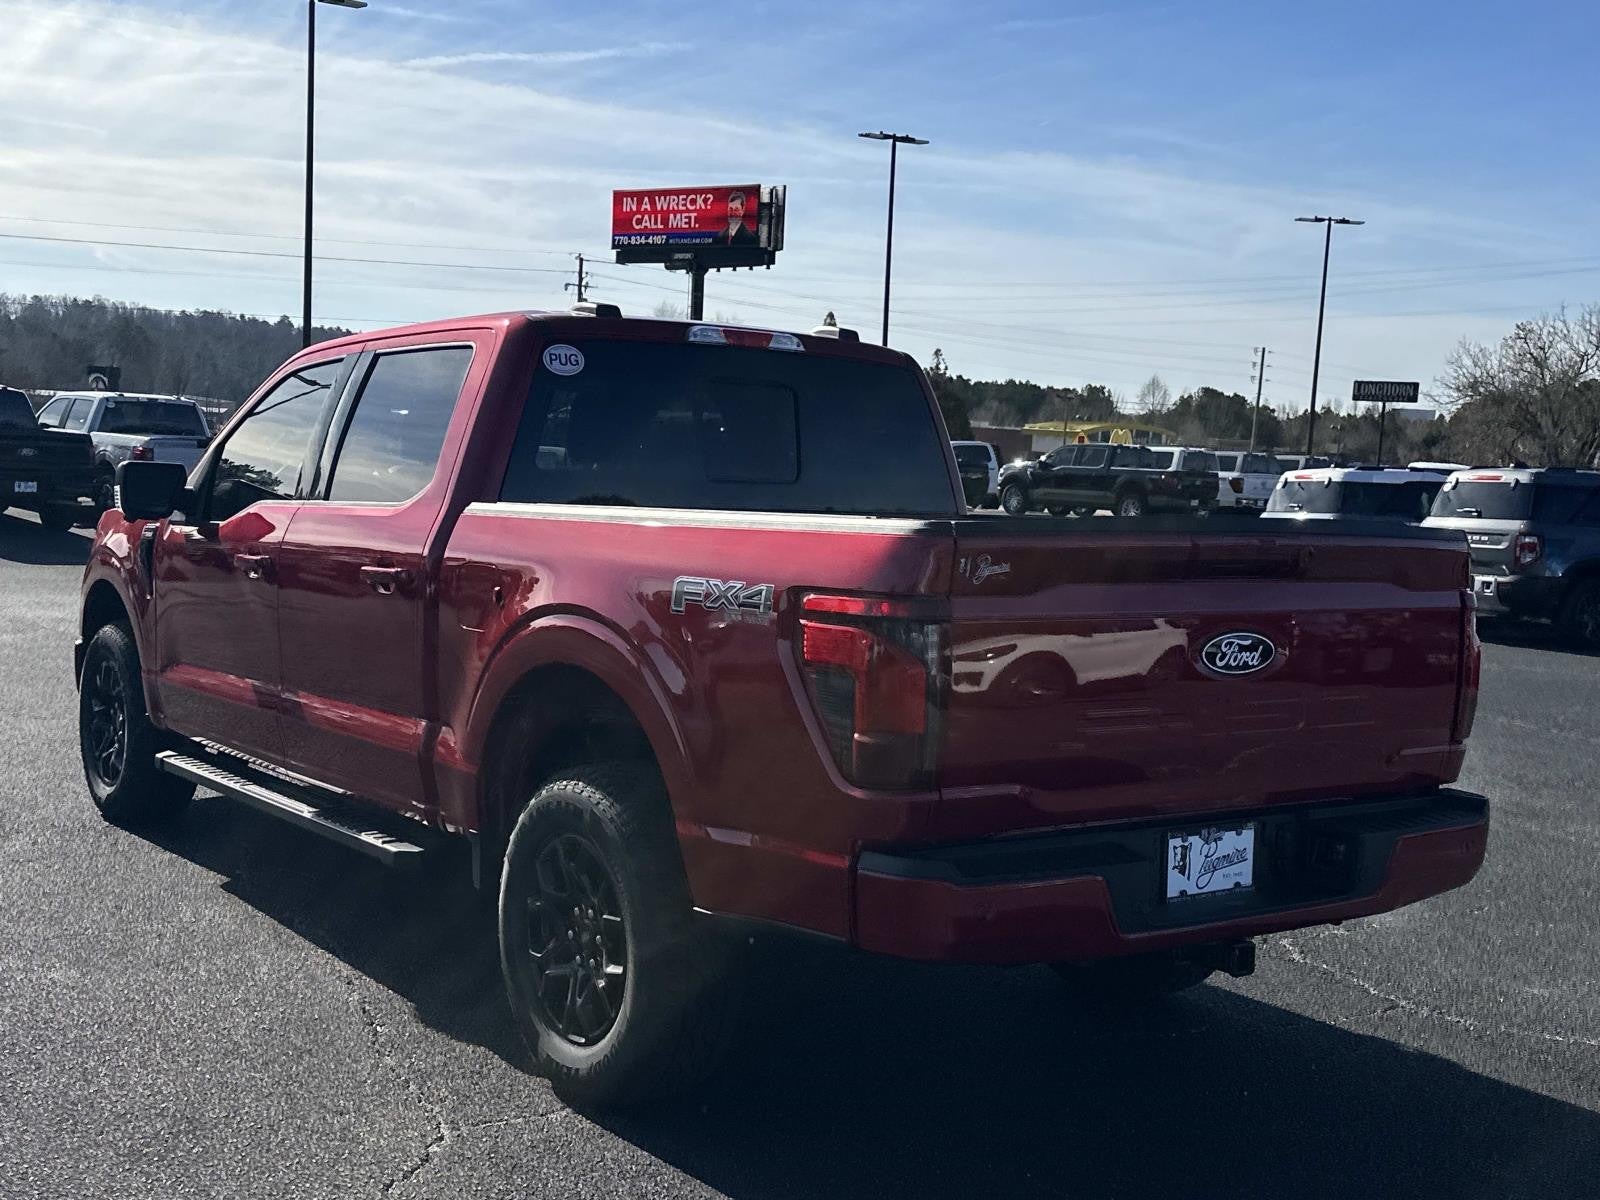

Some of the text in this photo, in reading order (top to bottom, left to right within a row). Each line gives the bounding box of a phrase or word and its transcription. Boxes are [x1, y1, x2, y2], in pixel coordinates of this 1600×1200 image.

[622, 194, 714, 212] IN A WRECK?
[632, 213, 699, 229] CALL MET.
[614, 235, 667, 245] 770-834-4107
[549, 353, 580, 367] PUG
[1354, 382, 1415, 397] LONGHORN
[670, 576, 775, 615] FX4
[1216, 639, 1263, 667] Ford
[1196, 840, 1249, 889] Pugmire
